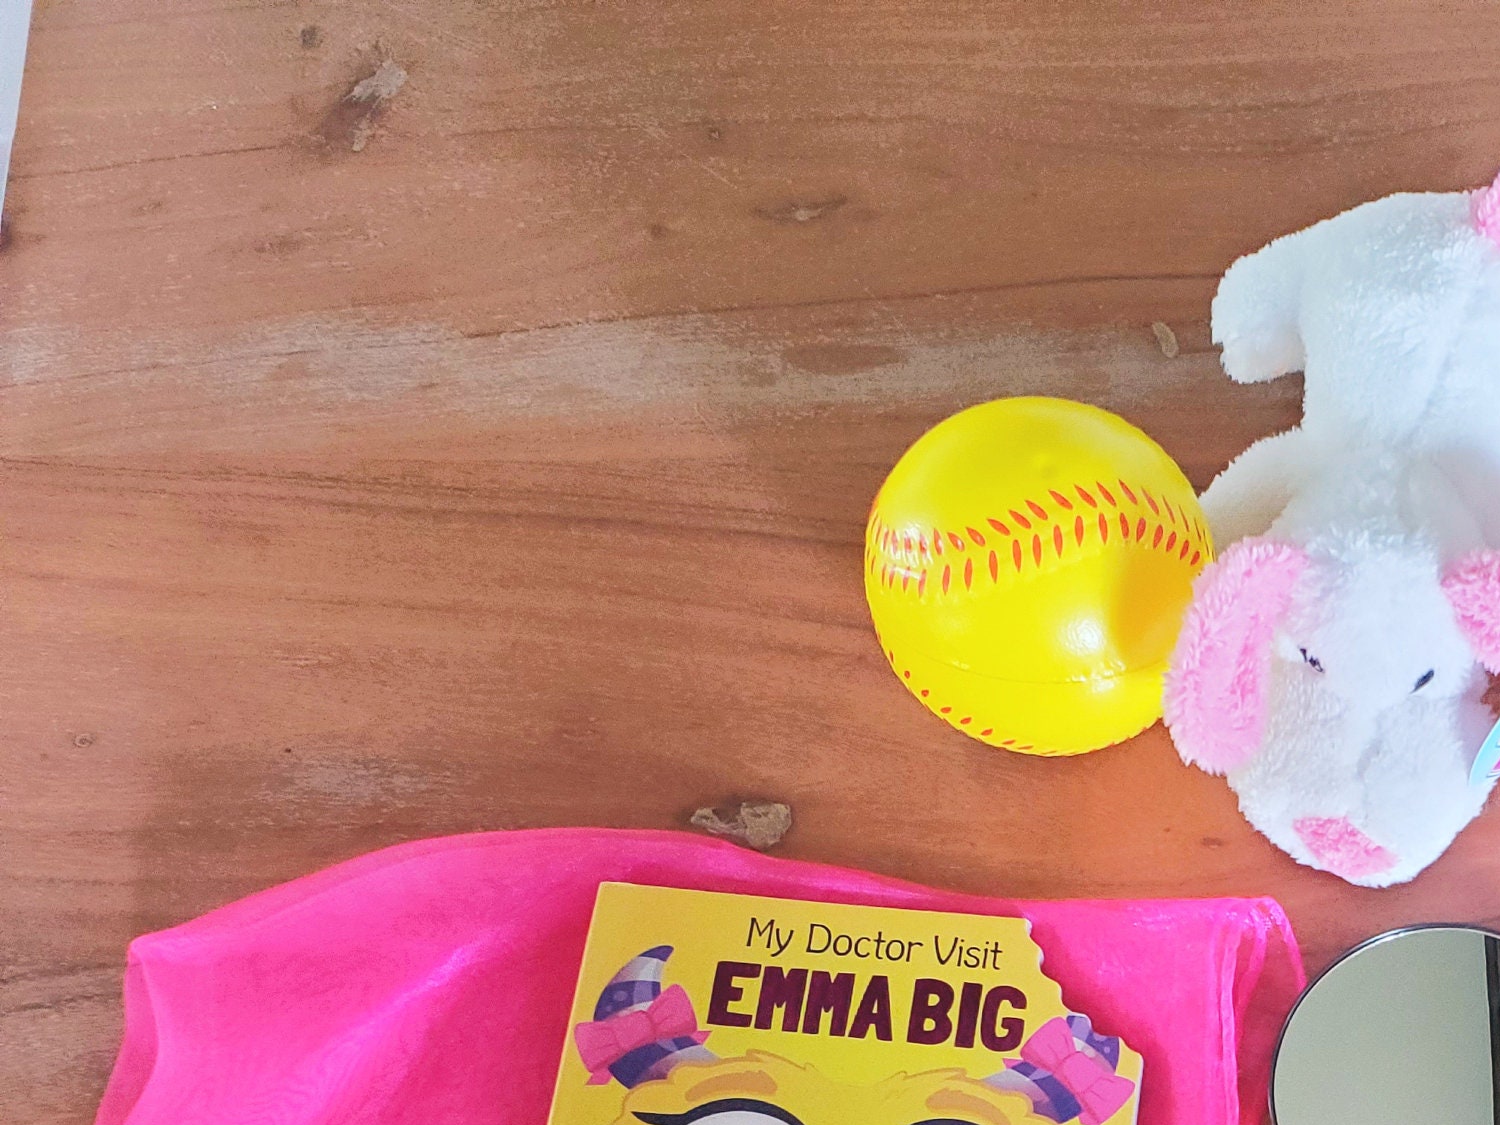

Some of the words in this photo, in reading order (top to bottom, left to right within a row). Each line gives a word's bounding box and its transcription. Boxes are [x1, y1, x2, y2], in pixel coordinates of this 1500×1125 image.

[746, 917, 794, 957] My
[805, 923, 923, 963] Doctor
[933, 935, 1003, 970] Visit
[706, 960, 893, 1042] EMMA
[906, 978, 1028, 1052] BIG
